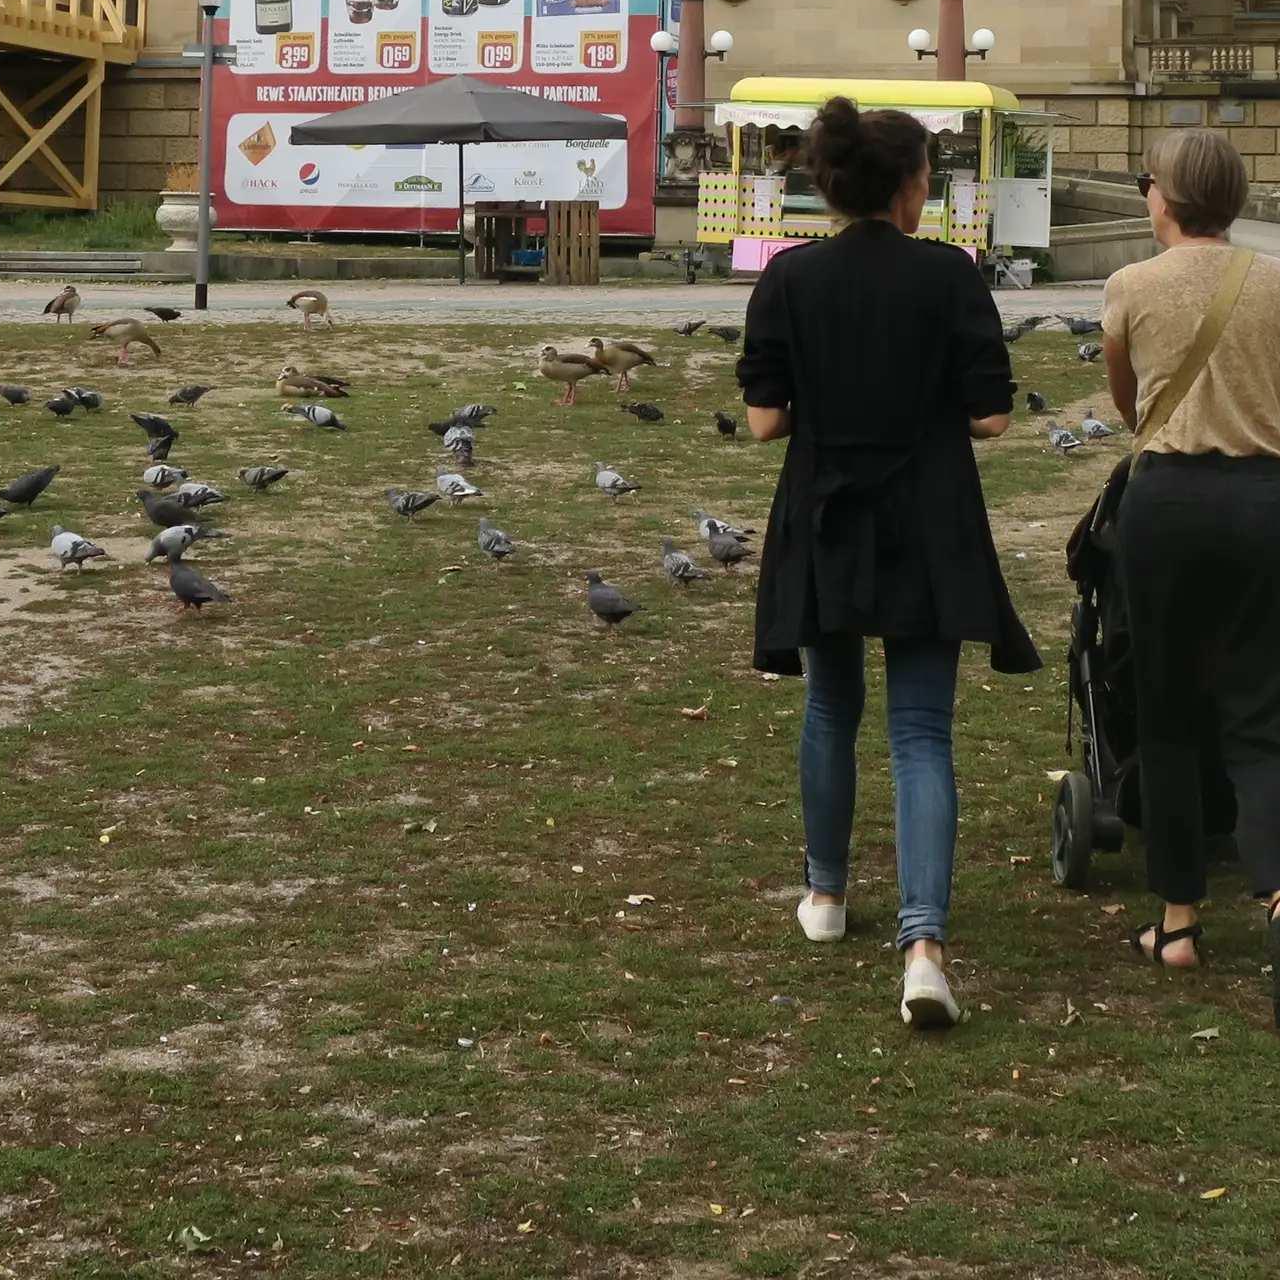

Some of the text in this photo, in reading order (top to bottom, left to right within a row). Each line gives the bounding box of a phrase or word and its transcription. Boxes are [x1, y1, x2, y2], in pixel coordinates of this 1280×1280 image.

[282, 46, 309, 67] 3.99
[383, 46, 410, 67] 0.69
[484, 45, 512, 67] 0.99
[587, 45, 614, 67] 1.88
[256, 86, 285, 102] REWE
[288, 86, 364, 102] STAATSTHEATER
[543, 85, 601, 102] PARTNERN.
[565, 139, 610, 150] Bonduelle
